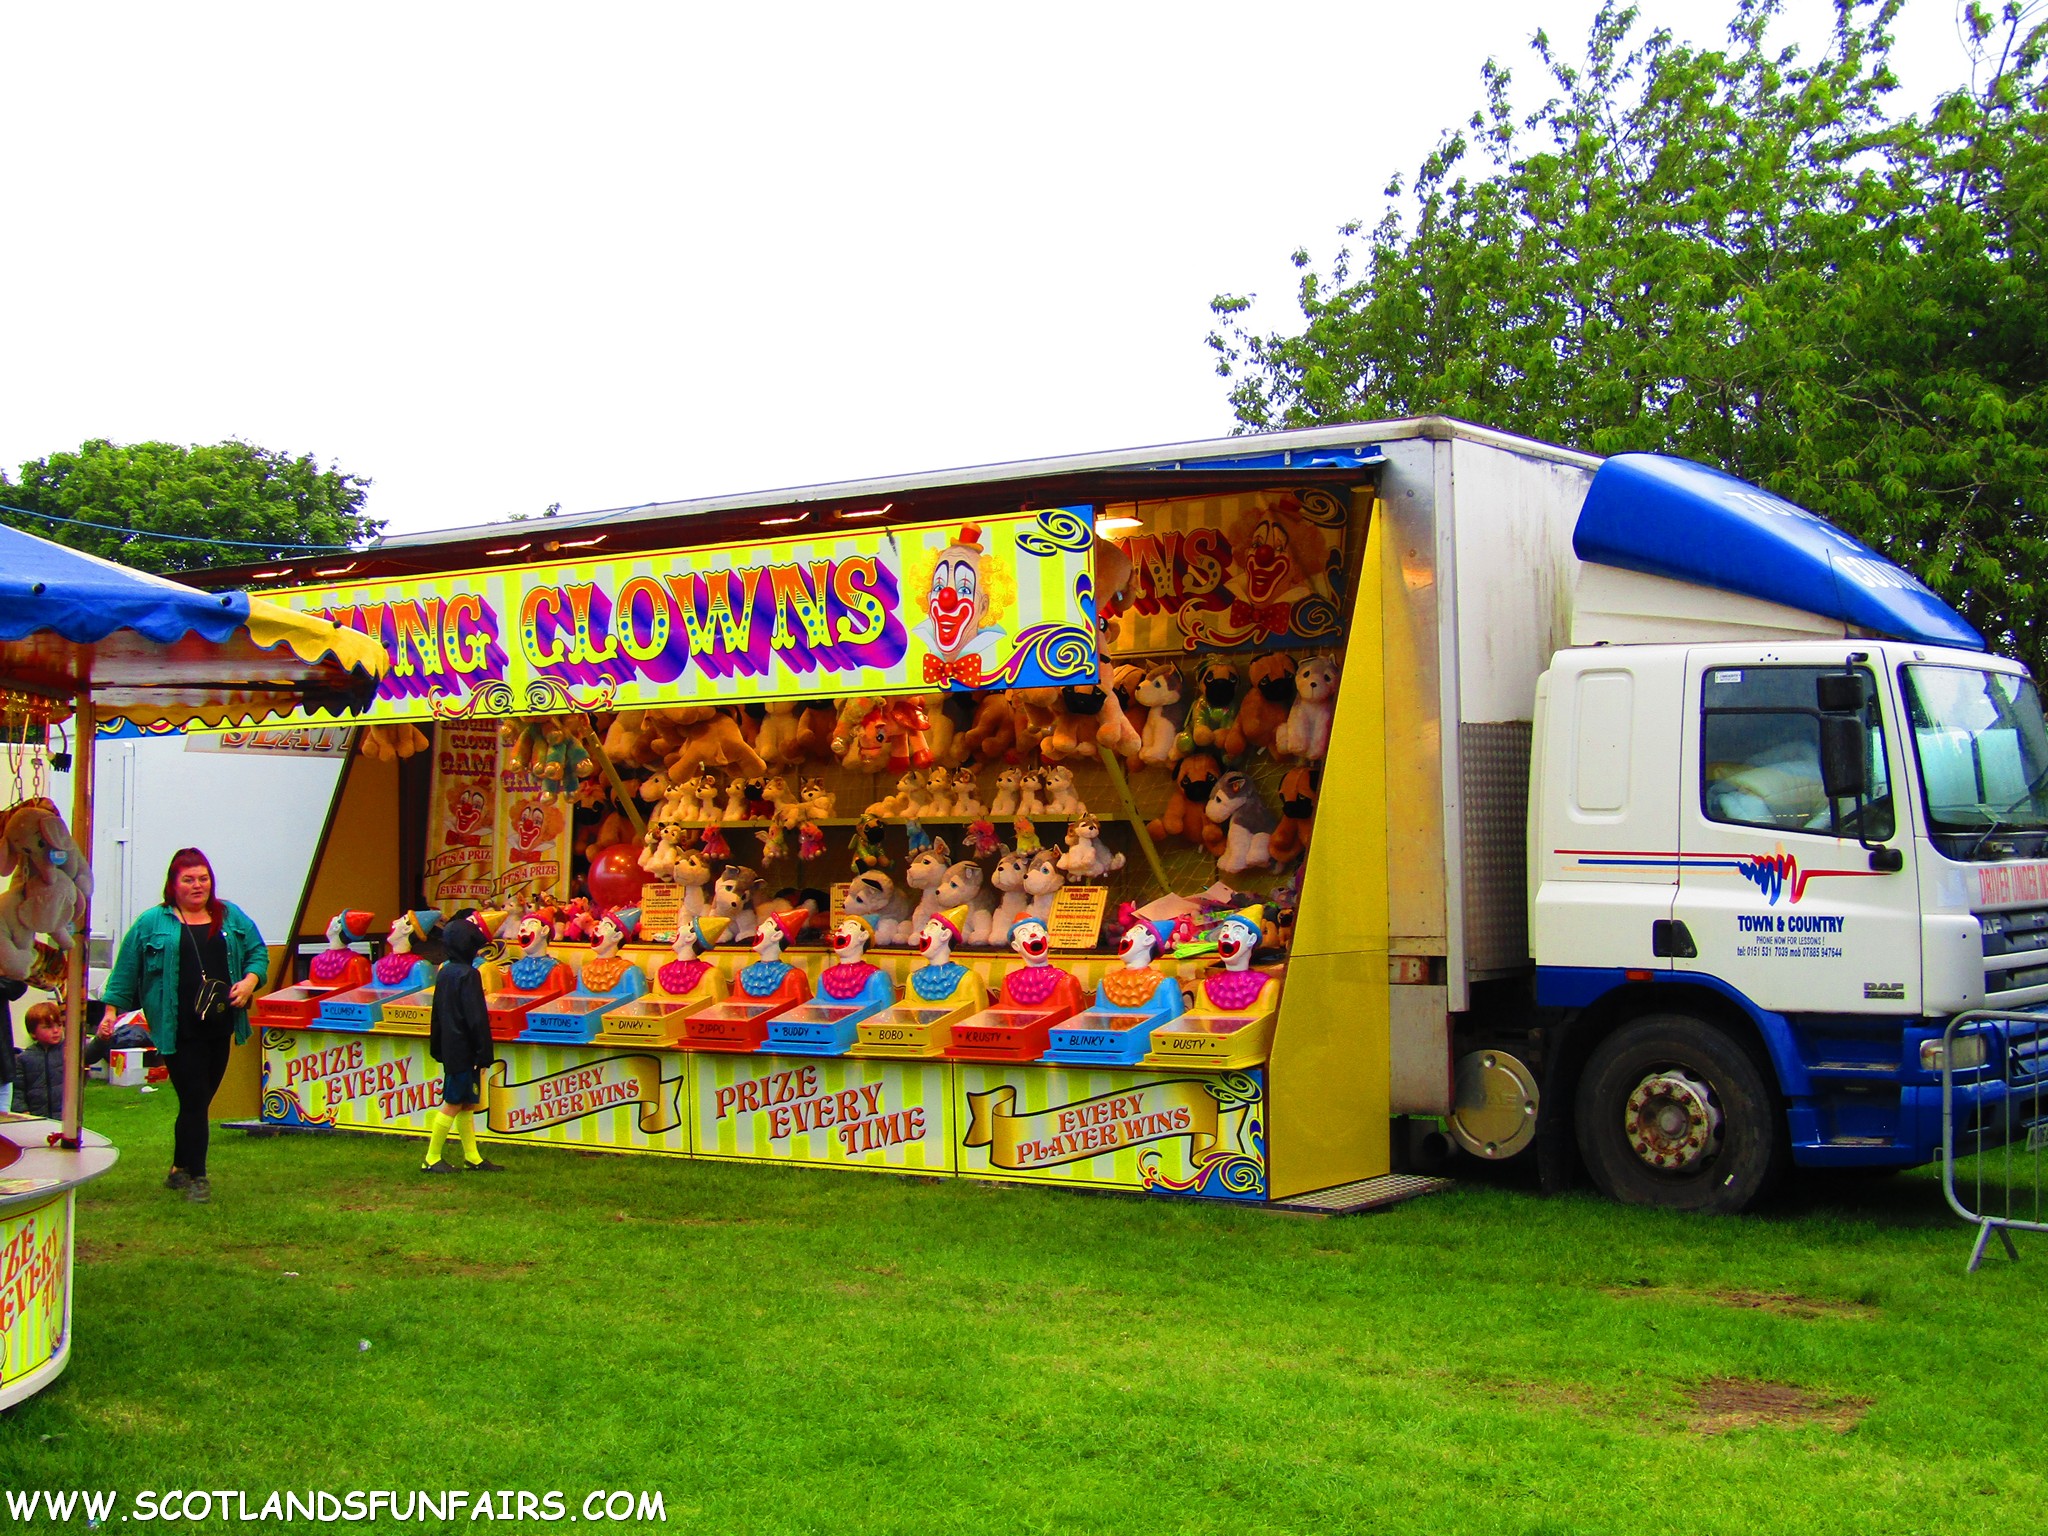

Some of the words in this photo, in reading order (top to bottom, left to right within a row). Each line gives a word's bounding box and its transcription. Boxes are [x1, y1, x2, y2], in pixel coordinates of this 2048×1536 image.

[1108, 528, 1232, 612] NS
[519, 555, 906, 686] CLOWNS
[439, 752, 496, 776] GAM
[468, 849, 491, 862] PRIZ
[502, 871, 520, 885] IT'S
[521, 868, 528, 878] A
[530, 865, 557, 877] PRIZE
[440, 885, 467, 895] EVERY
[469, 885, 490, 895] TIME
[1737, 915, 1774, 932] TOWN
[1777, 916, 1785, 932] &
[1788, 916, 1845, 933] COUNTRY
[1982, 918, 2002, 935] AF
[1756, 936, 1773, 945] PHONE
[1774, 936, 1786, 945] NOW
[1787, 936, 1797, 945] FOR
[1798, 937, 1821, 946] LESSONS
[1746, 946, 1760, 957] 0151
[1762, 947, 1772, 957] 531
[1790, 948, 1801, 957] mob
[1864, 982, 1904, 991] DAF
[330, 1007, 355, 1016] CLUMSY
[394, 1009, 418, 1019] BONZO
[540, 1017, 572, 1028] BUTTONS
[618, 1020, 644, 1030] DINKY
[698, 1023, 725, 1034] ZIPPO
[783, 1027, 809, 1037] BUDDY
[879, 1030, 904, 1040] BOBO
[965, 1031, 1001, 1042] KRUSTY
[1069, 1035, 1104, 1046] BLINKY
[1173, 1038, 1206, 1050] DUSTY
[285, 1041, 363, 1087] PRIZE
[325, 1056, 412, 1106] EVERY
[539, 1066, 604, 1102] EVERY
[379, 1078, 445, 1119] TIME
[715, 1065, 818, 1120] PRIZE
[507, 1093, 584, 1129] PLAYER
[588, 1079, 640, 1107] WINS
[768, 1082, 883, 1140] EVERY
[1058, 1092, 1145, 1134] EVERY
[839, 1107, 926, 1155] TIME
[1016, 1121, 1118, 1164] PLAYER
[1123, 1107, 1191, 1140] WINS
